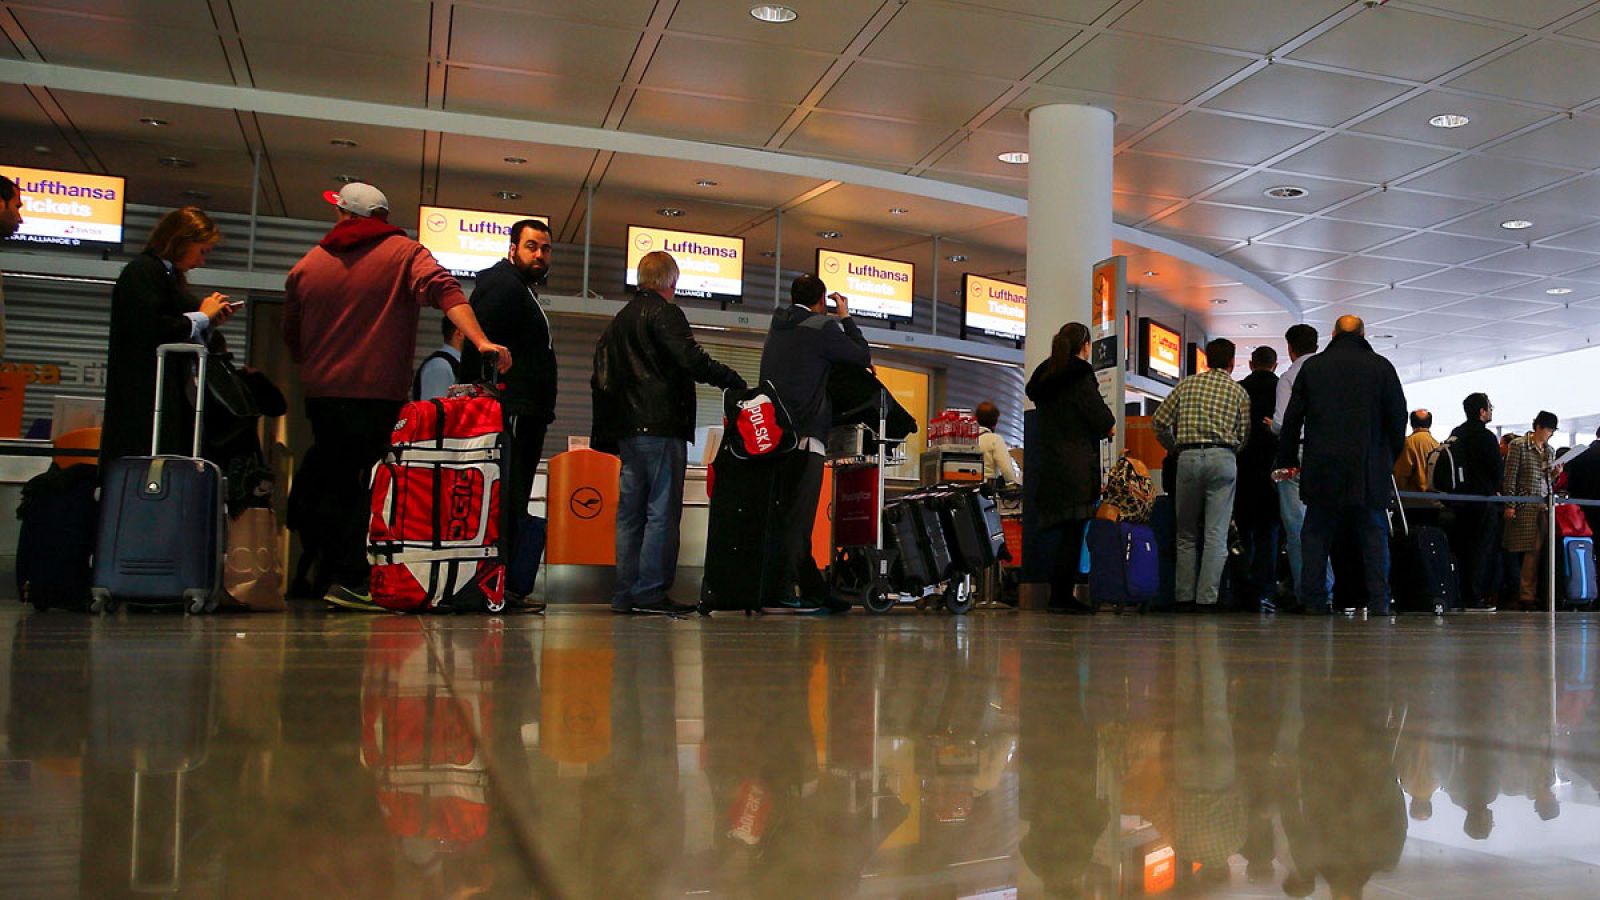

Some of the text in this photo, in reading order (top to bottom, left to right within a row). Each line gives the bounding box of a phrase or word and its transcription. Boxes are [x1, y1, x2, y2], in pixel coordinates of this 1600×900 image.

[15, 177, 116, 201] Lufthansa
[459, 219, 512, 236] Luftha
[664, 239, 737, 258] Lufthansa
[848, 262, 909, 282] Lufthansa
[748, 406, 772, 451] POLSKA
